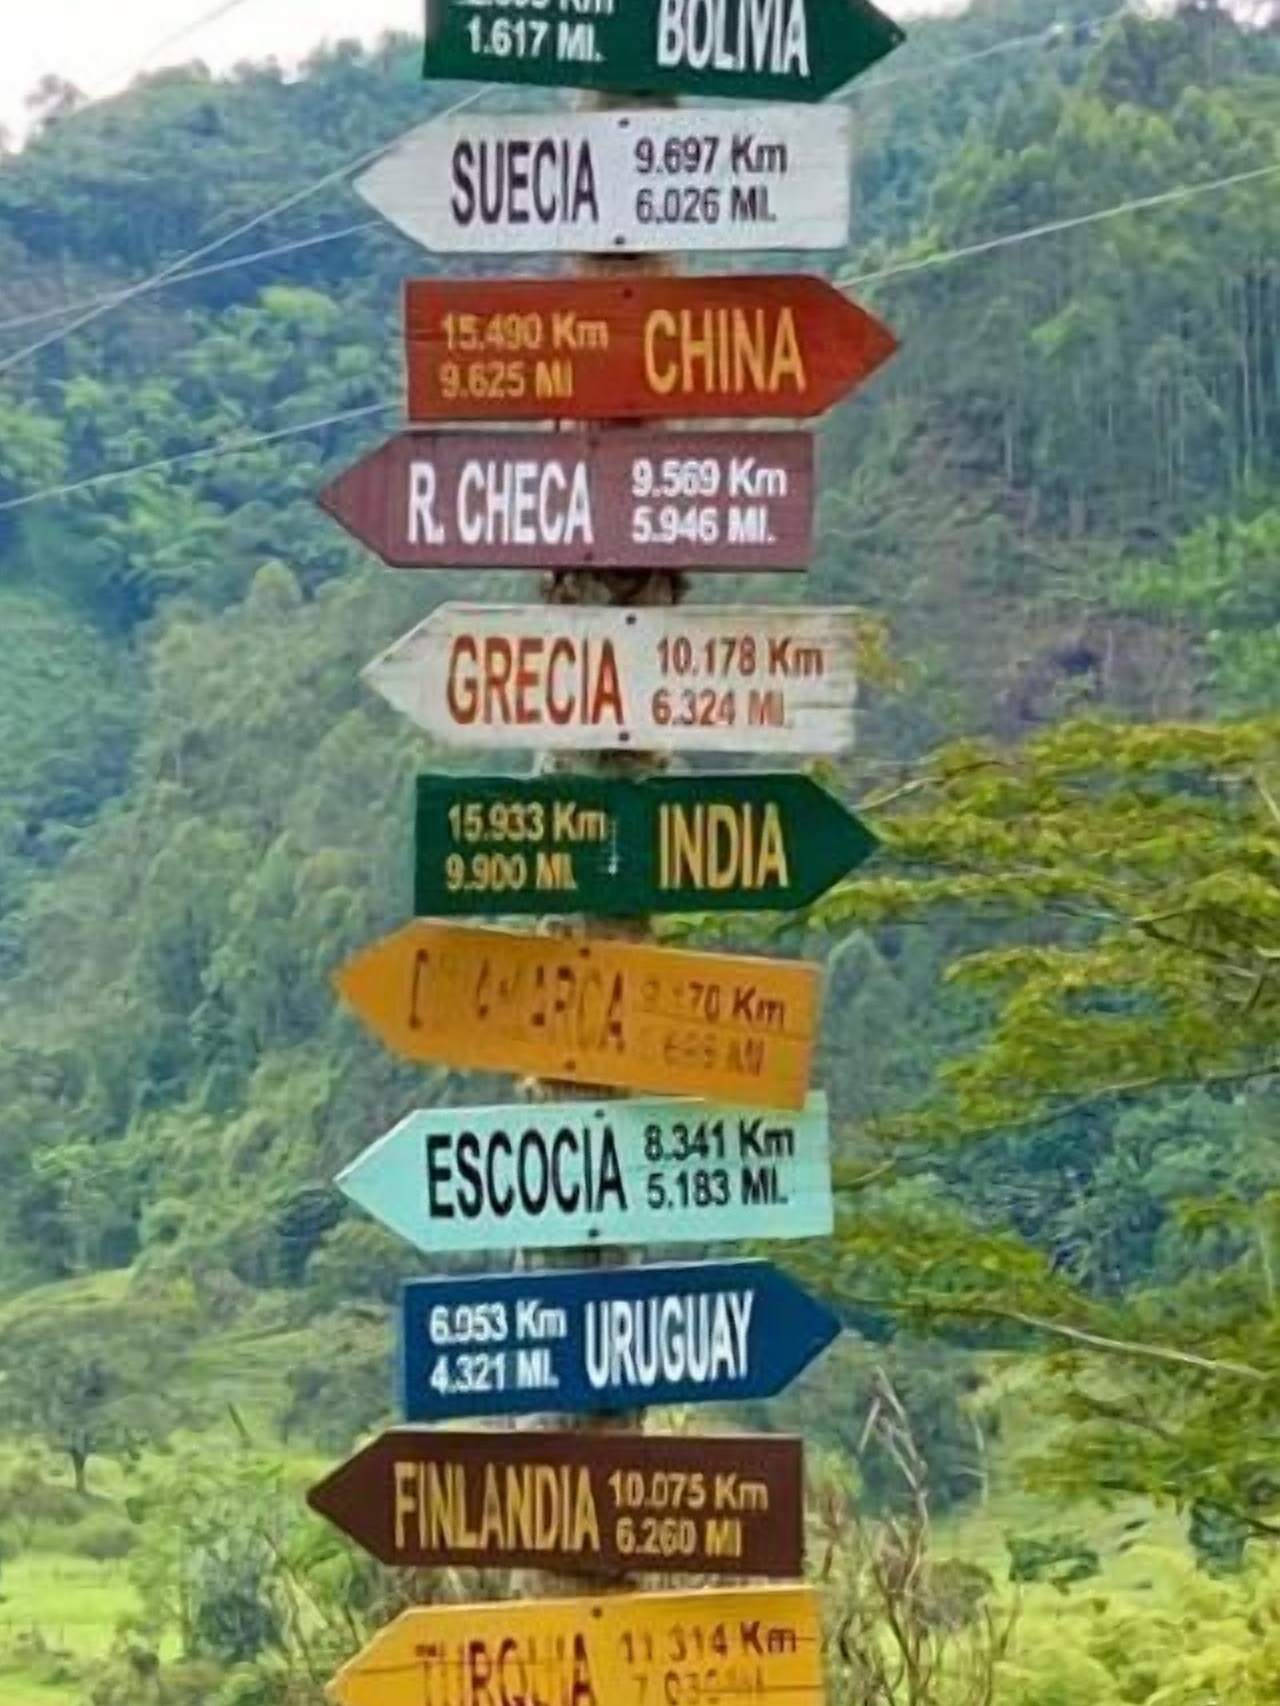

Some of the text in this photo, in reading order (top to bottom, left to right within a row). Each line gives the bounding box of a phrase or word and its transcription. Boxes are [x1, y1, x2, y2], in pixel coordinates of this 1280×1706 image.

[467, 14, 549, 59] 1.617
[635, 134, 788, 175] 9.697 Km
[451, 140, 599, 226] SUECIA
[636, 185, 720, 224] 6.026
[441, 311, 609, 352] 15.490 Km
[644, 306, 806, 394] CHINA
[440, 359, 526, 399] 9.625
[631, 456, 788, 498] 9.569 Km
[408, 462, 593, 546] R. CHECA
[631, 504, 720, 544] 5.946
[657, 634, 824, 677] 10.178 Km
[447, 635, 624, 726] GRECIA
[651, 687, 737, 726] 6.324
[447, 800, 606, 843] 15.933 Km
[658, 802, 789, 891] INDIA
[445, 852, 528, 891] 9.900
[732, 984, 786, 1030] Km
[644, 1117, 794, 1162] 8.341 Km
[425, 1124, 627, 1218] ESCOCIA
[647, 1166, 730, 1209] 5.183
[516, 1299, 567, 1341] Km
[584, 1291, 754, 1389] URUGUAY
[429, 1352, 506, 1394] 4.321
[393, 1461, 600, 1553] FINLANDIA
[608, 1468, 769, 1510] 10.075 Km
[616, 1516, 698, 1557] 6.260
[740, 1621, 798, 1658] Km
